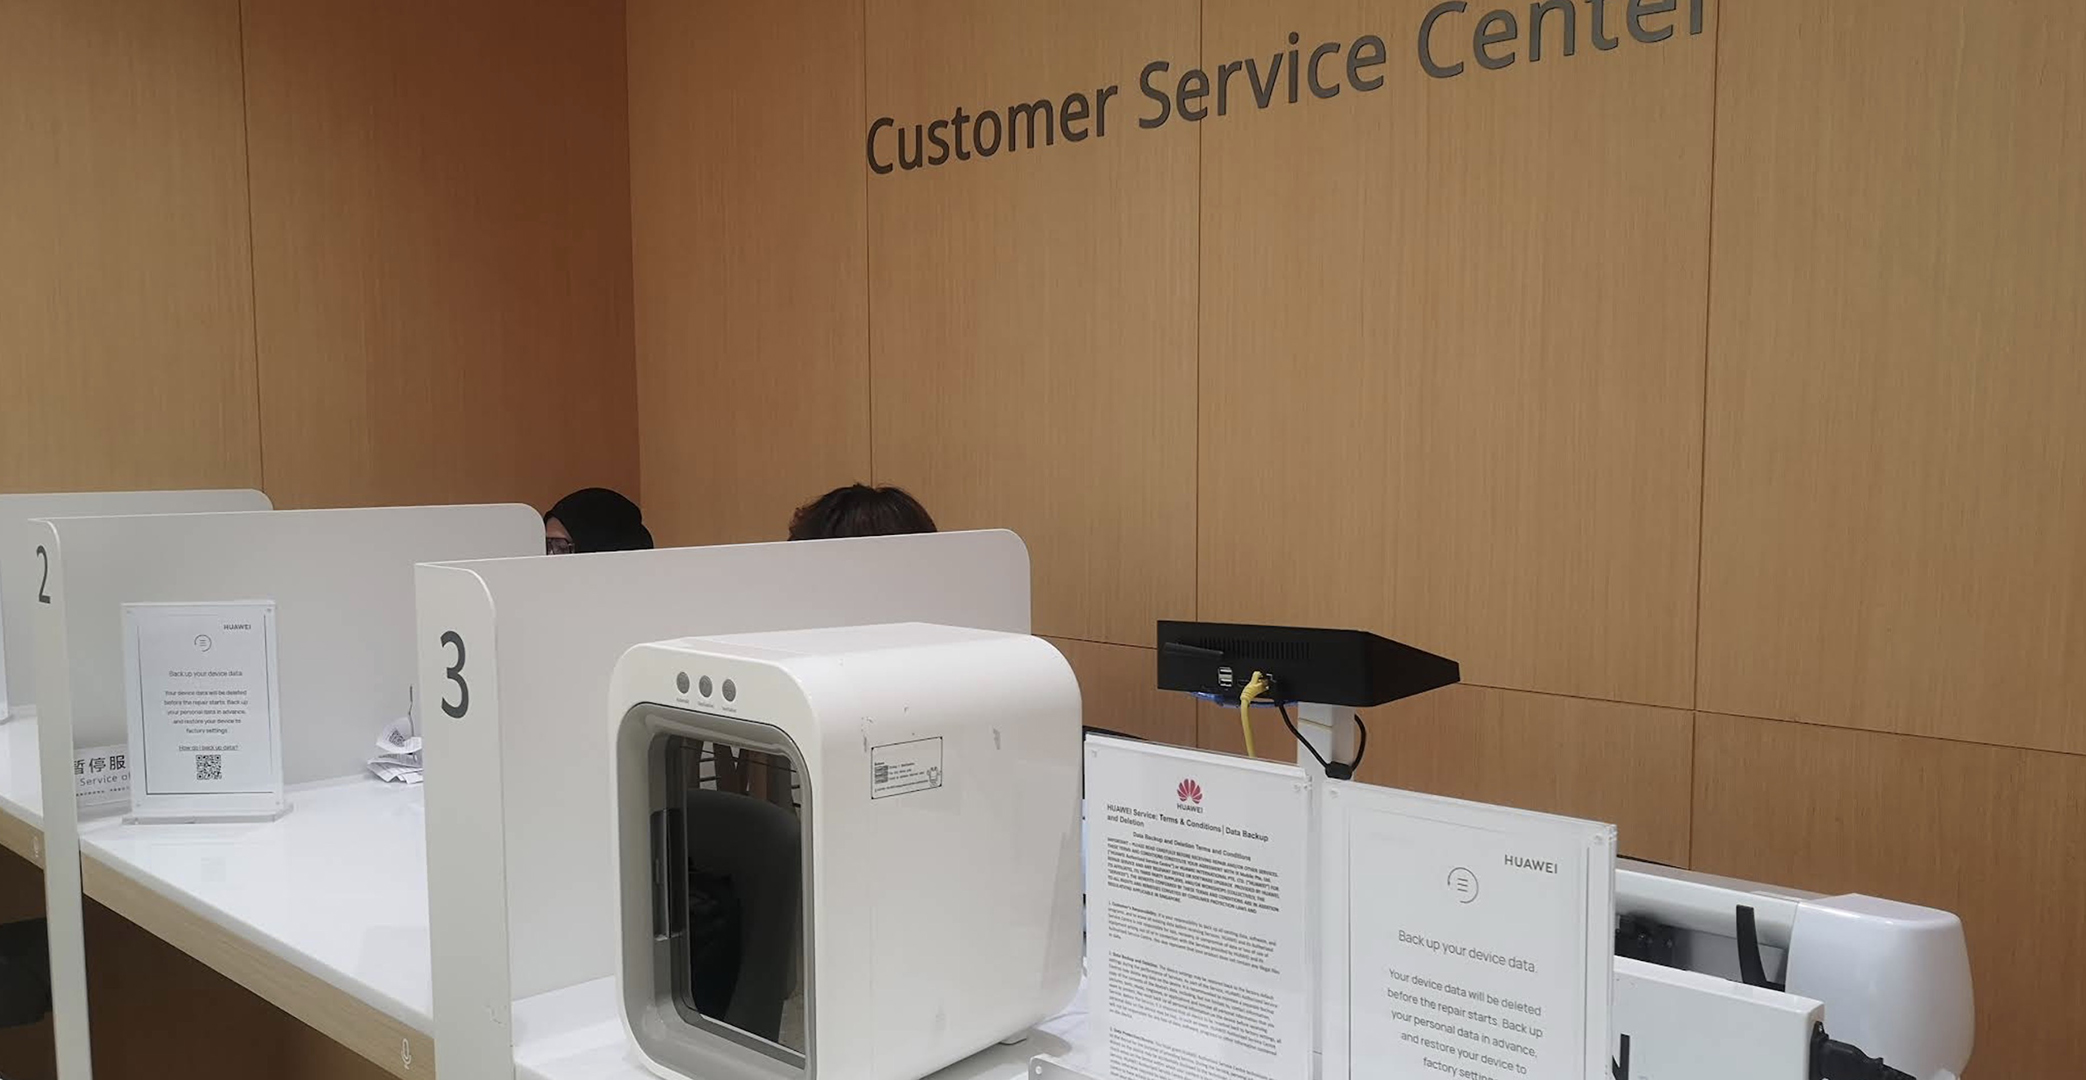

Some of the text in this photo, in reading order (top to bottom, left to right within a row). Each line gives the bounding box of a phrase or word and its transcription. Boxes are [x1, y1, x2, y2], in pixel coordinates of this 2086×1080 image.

[867, 85, 1118, 174] Customer
[1138, 32, 1387, 130] Service
[36, 545, 51, 604] 2
[440, 630, 469, 719] 3
[80, 775, 117, 786] Service
[1107, 804, 1132, 815] HUAWEI
[1160, 814, 1178, 824] Terms
[1186, 819, 1221, 832] Conditions
[1226, 827, 1240, 836] Data
[1242, 830, 1269, 842] Backup
[1120, 816, 1144, 828] Deletion
[1177, 803, 1203, 814] HUAWEI
[1505, 854, 1557, 874] HUAWEI
[1398, 930, 1424, 946] Back
[1426, 939, 1440, 952] up
[1442, 943, 1467, 956] your
[1468, 948, 1506, 966] device
[1389, 969, 1542, 1016] Your device data will be deleted
[1387, 988, 1418, 1006] before
[1420, 997, 1436, 1009] the
[1438, 1003, 1467, 1017] repair
[1502, 1018, 1527, 1034] Back
[1529, 1025, 1543, 1038] up
[1391, 1010, 1412, 1022] your
[1414, 1016, 1456, 1035] personal
[1457, 1028, 1480, 1041] data
[1481, 1033, 1490, 1044] in
[1401, 1032, 1527, 1074] and restore your device to
[1423, 1057, 1458, 1077] factory
